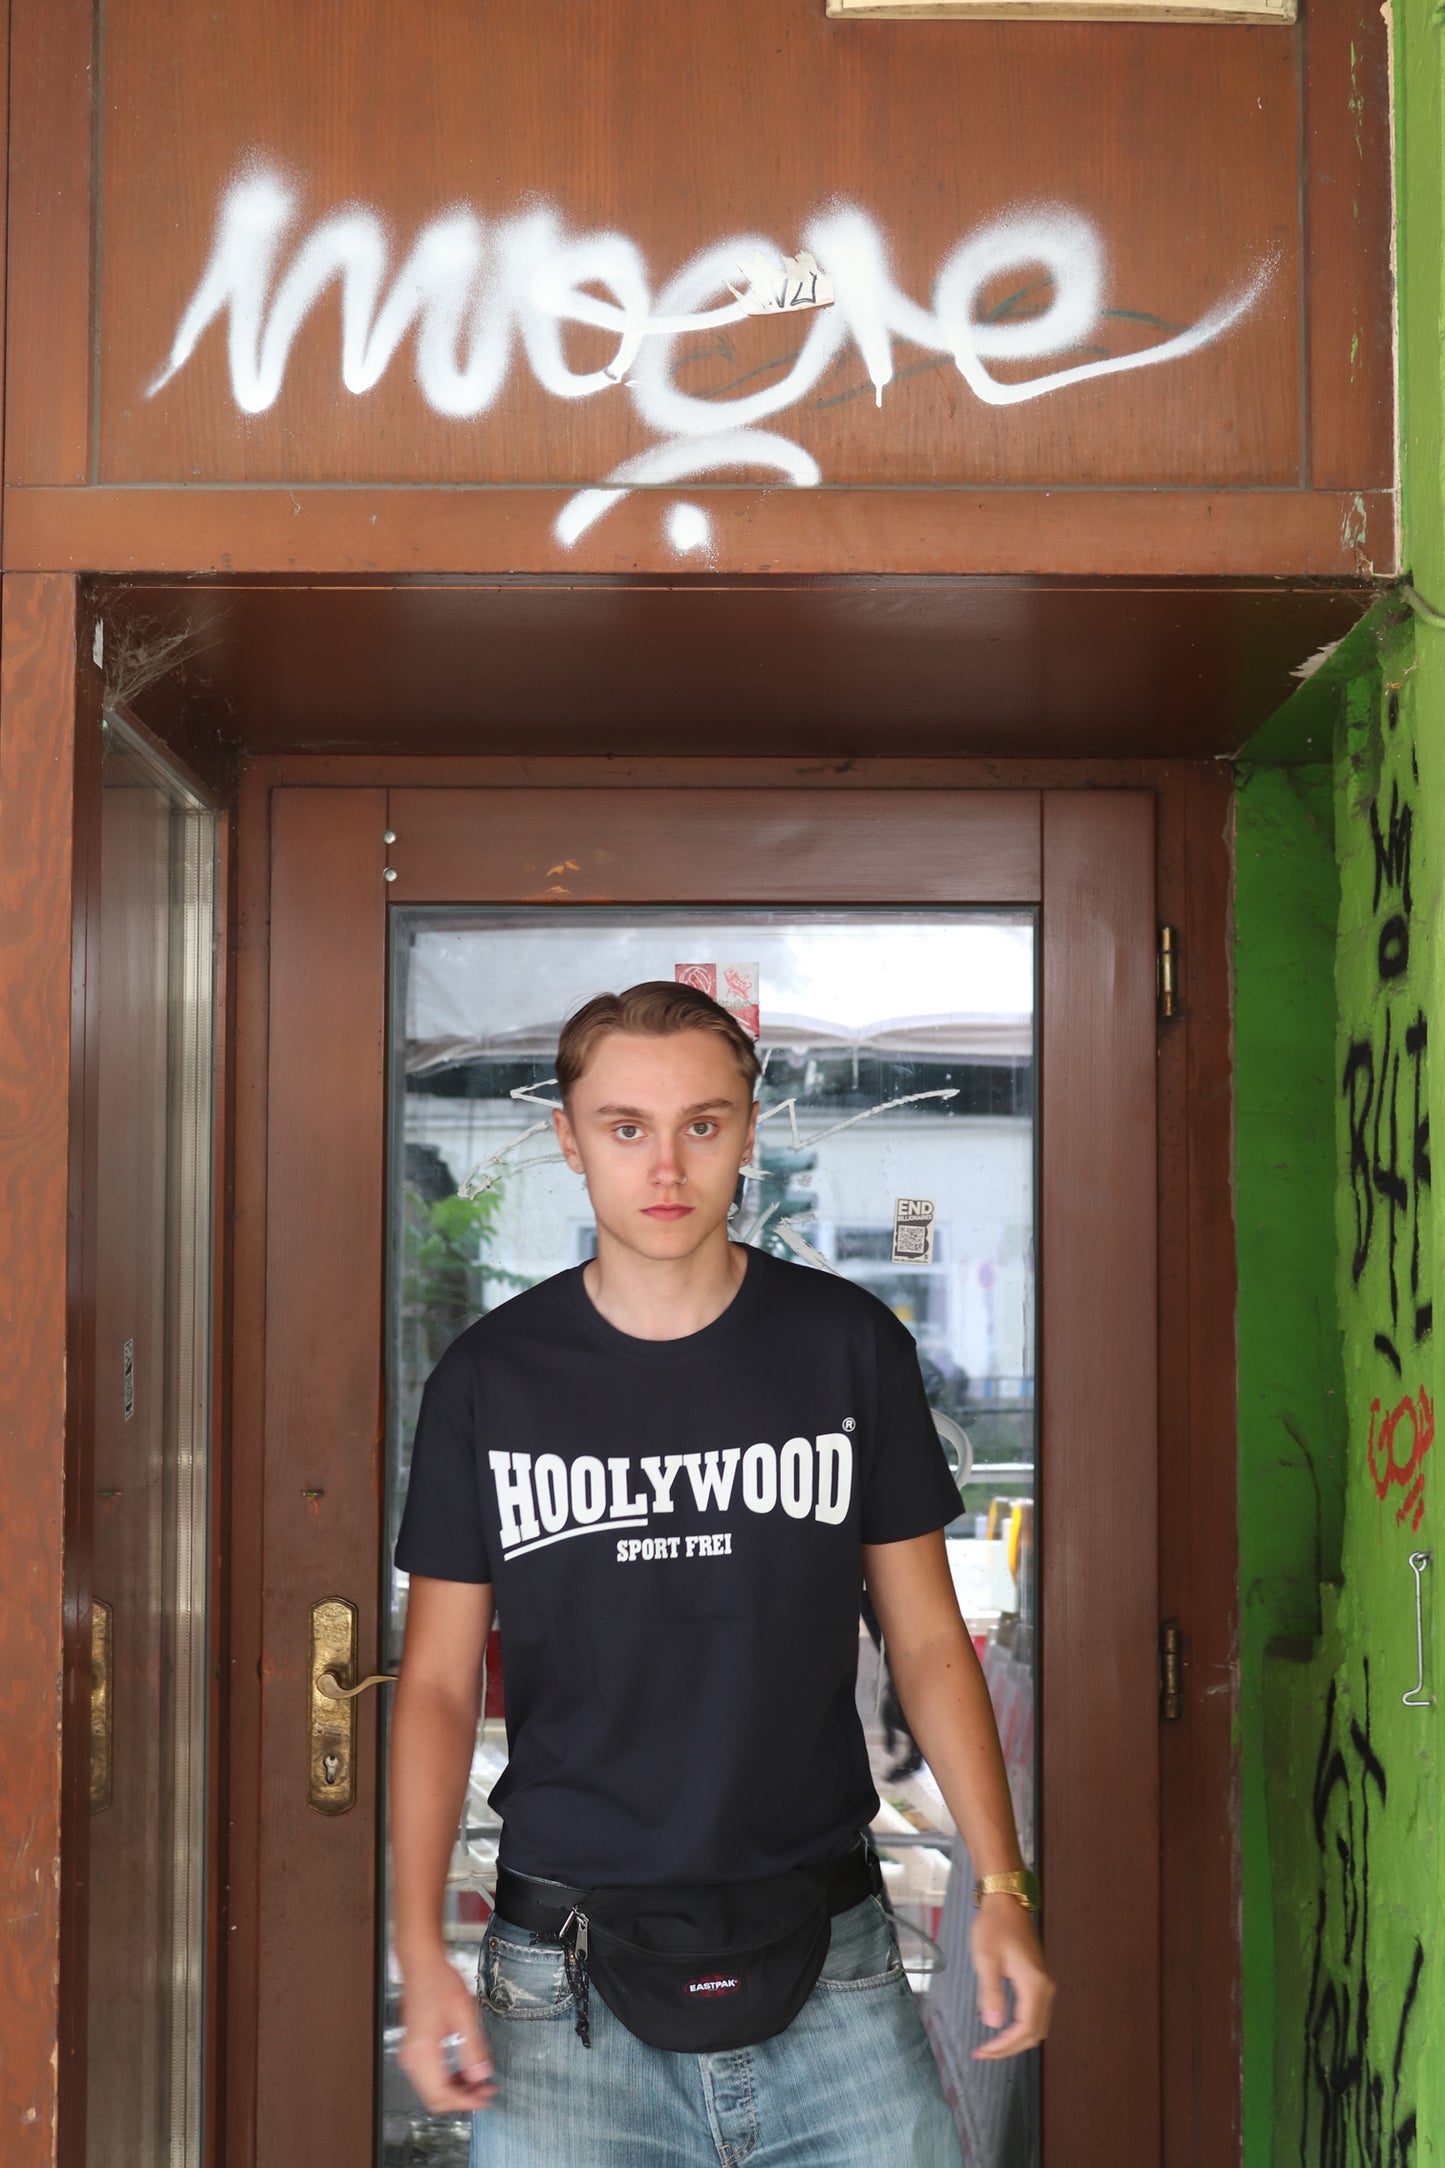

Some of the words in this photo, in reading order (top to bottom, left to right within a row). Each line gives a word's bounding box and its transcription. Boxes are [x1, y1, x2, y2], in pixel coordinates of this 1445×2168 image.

[898, 1199, 935, 1215] END
[616, 1536, 680, 1562] SPORT
[685, 1532, 733, 1558] FREI
[690, 1979, 735, 1992] EASTPAK
